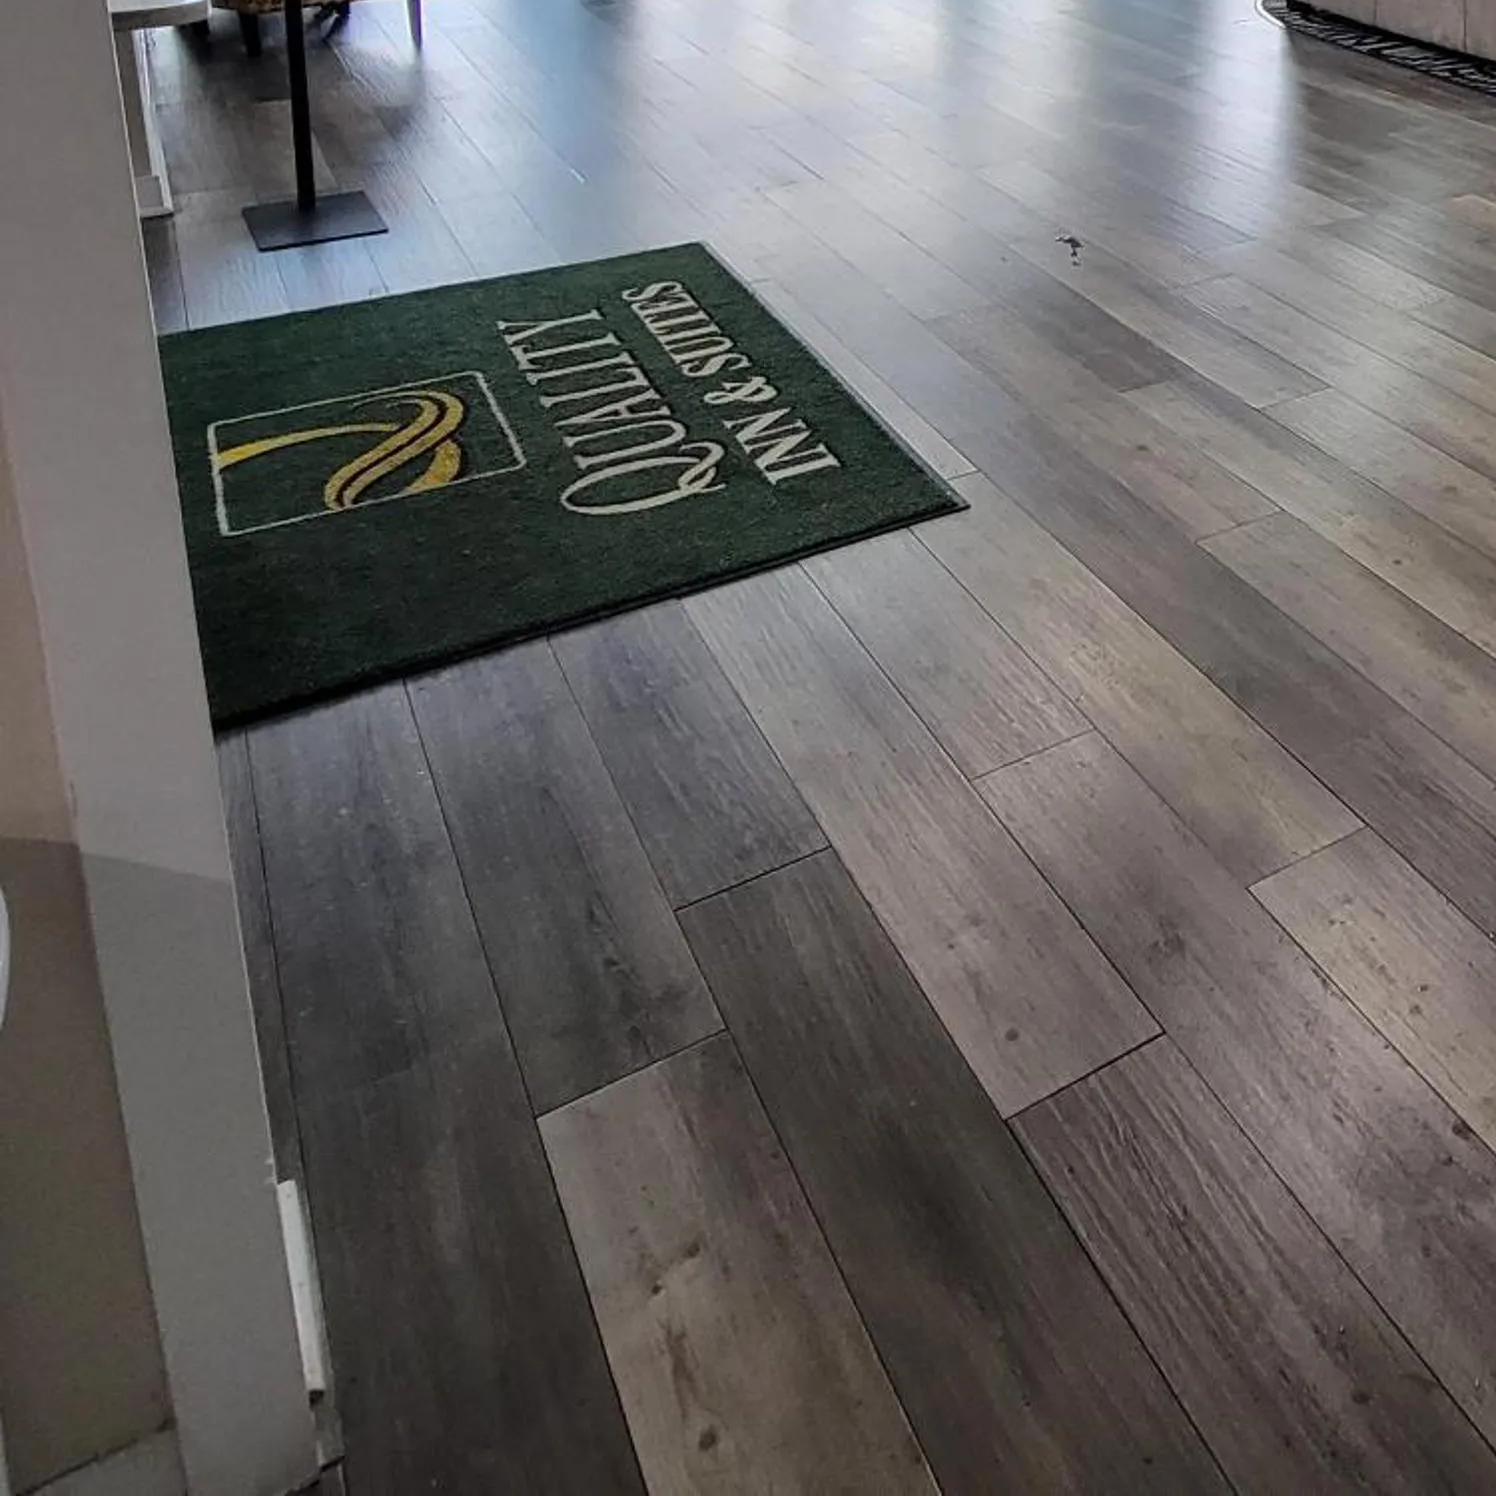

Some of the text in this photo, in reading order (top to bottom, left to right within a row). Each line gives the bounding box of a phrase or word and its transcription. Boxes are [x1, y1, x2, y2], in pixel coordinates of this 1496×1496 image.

[497, 308, 727, 516] QUALITY
[621, 280, 841, 485] INN & SUITES
